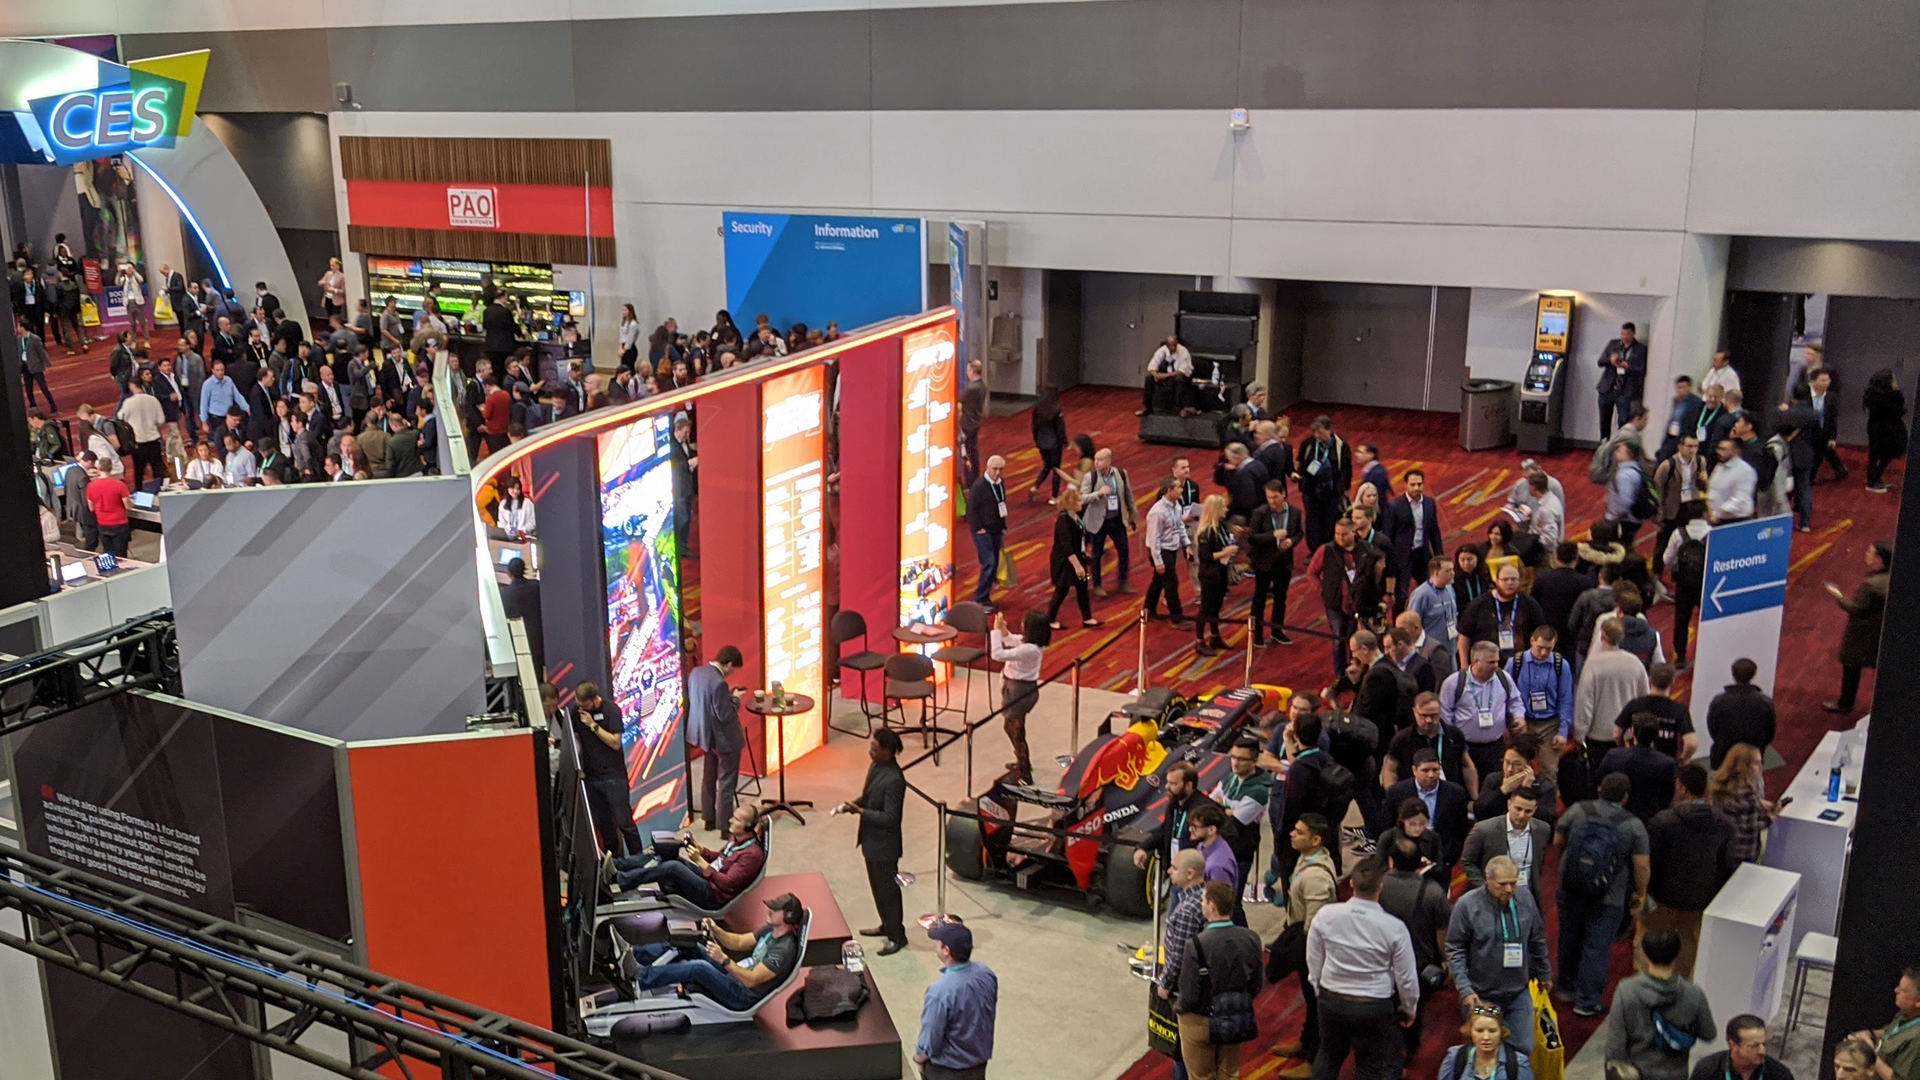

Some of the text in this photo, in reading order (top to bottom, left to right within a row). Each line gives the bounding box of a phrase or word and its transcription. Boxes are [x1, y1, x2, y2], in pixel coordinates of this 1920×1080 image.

[52, 88, 168, 148] CES
[450, 194, 491, 217] PAO
[731, 220, 773, 237] Security
[814, 223, 879, 239] Information
[1713, 553, 1767, 574] Restrooms
[42, 800, 200, 856] advertising, particularly in the European
[44, 812, 194, 866] market. There are about 500m people
[56, 792, 200, 845] We're also using Formula 1 for brand
[1102, 804, 1140, 824] ONDA
[46, 823, 207, 882] who watch F1 every year, who tend to be
[48, 834, 206, 894] people who are interested in technology
[50, 845, 190, 898] that are a good fit to our customers.
